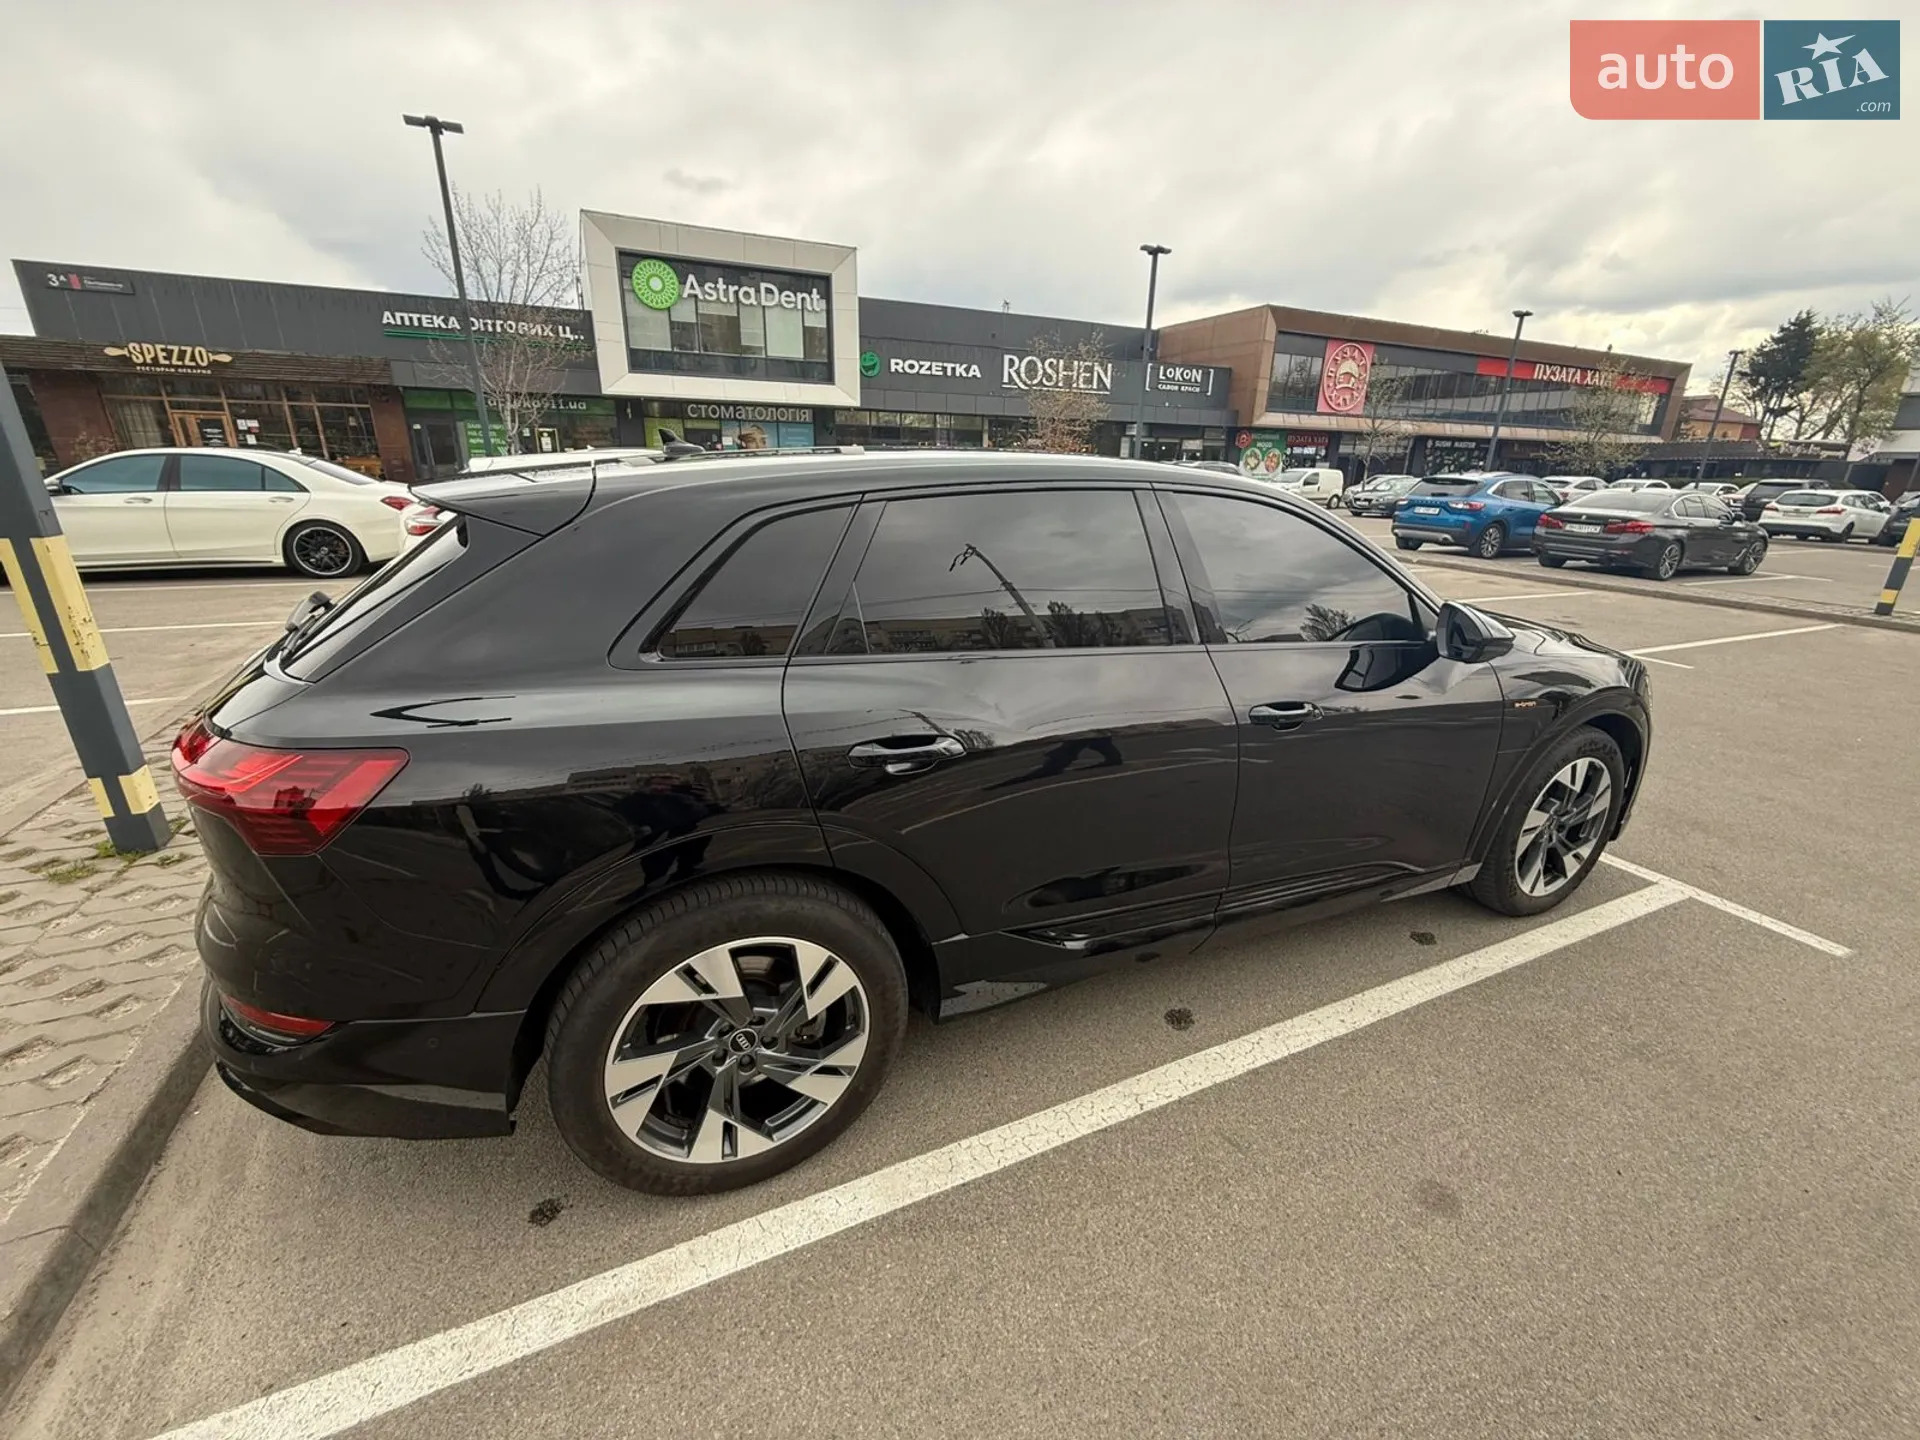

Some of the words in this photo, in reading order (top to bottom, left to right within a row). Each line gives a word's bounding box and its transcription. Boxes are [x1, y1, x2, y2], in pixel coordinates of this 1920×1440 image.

[682, 273, 821, 312] AstraDent
[382, 311, 461, 330] АПТЕКА
[128, 342, 209, 367] SPEZZO
[890, 358, 982, 379] ROZETKA
[1002, 353, 1113, 391] ROSHEN
[1533, 363, 1581, 384] ПУЗАТА
